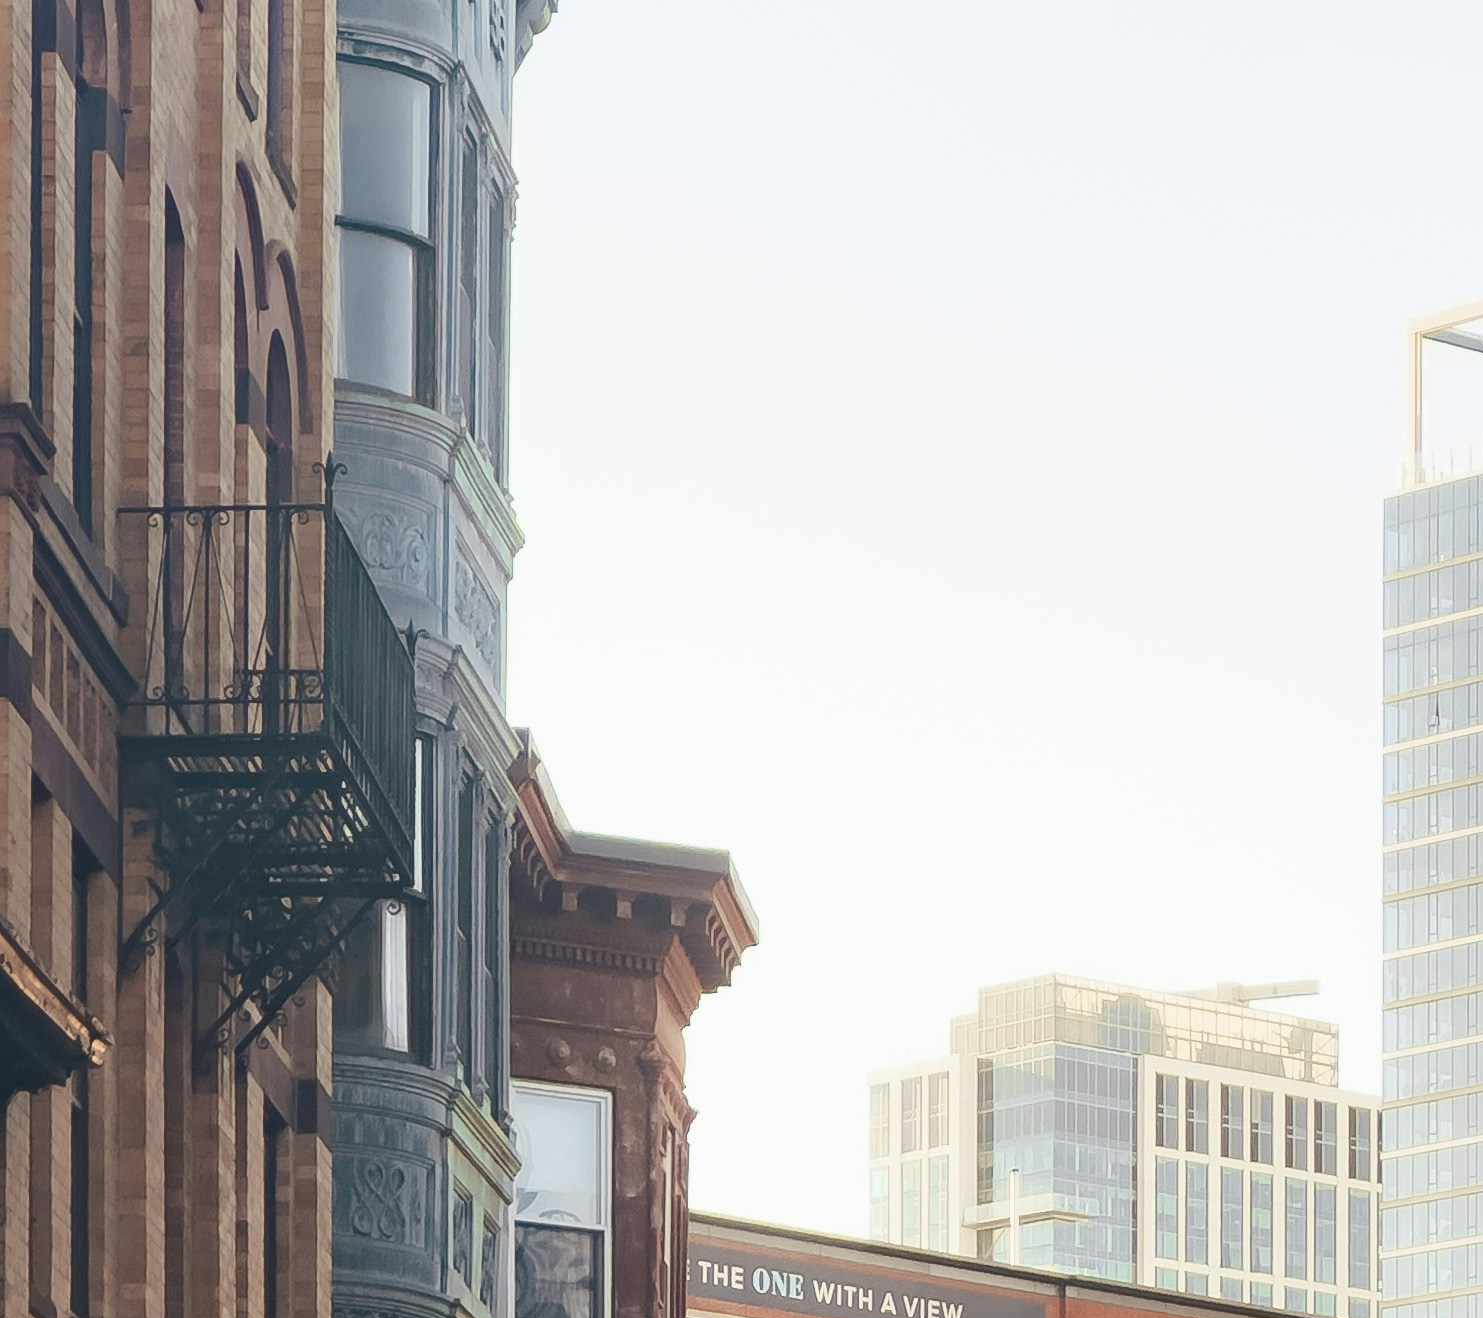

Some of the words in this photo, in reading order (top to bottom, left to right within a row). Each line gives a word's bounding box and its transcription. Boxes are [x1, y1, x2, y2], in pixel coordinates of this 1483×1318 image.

[698, 1260, 744, 1290] THE
[752, 1267, 804, 1300] ONE
[813, 1279, 873, 1312] WITH
[880, 1292, 898, 1315] A
